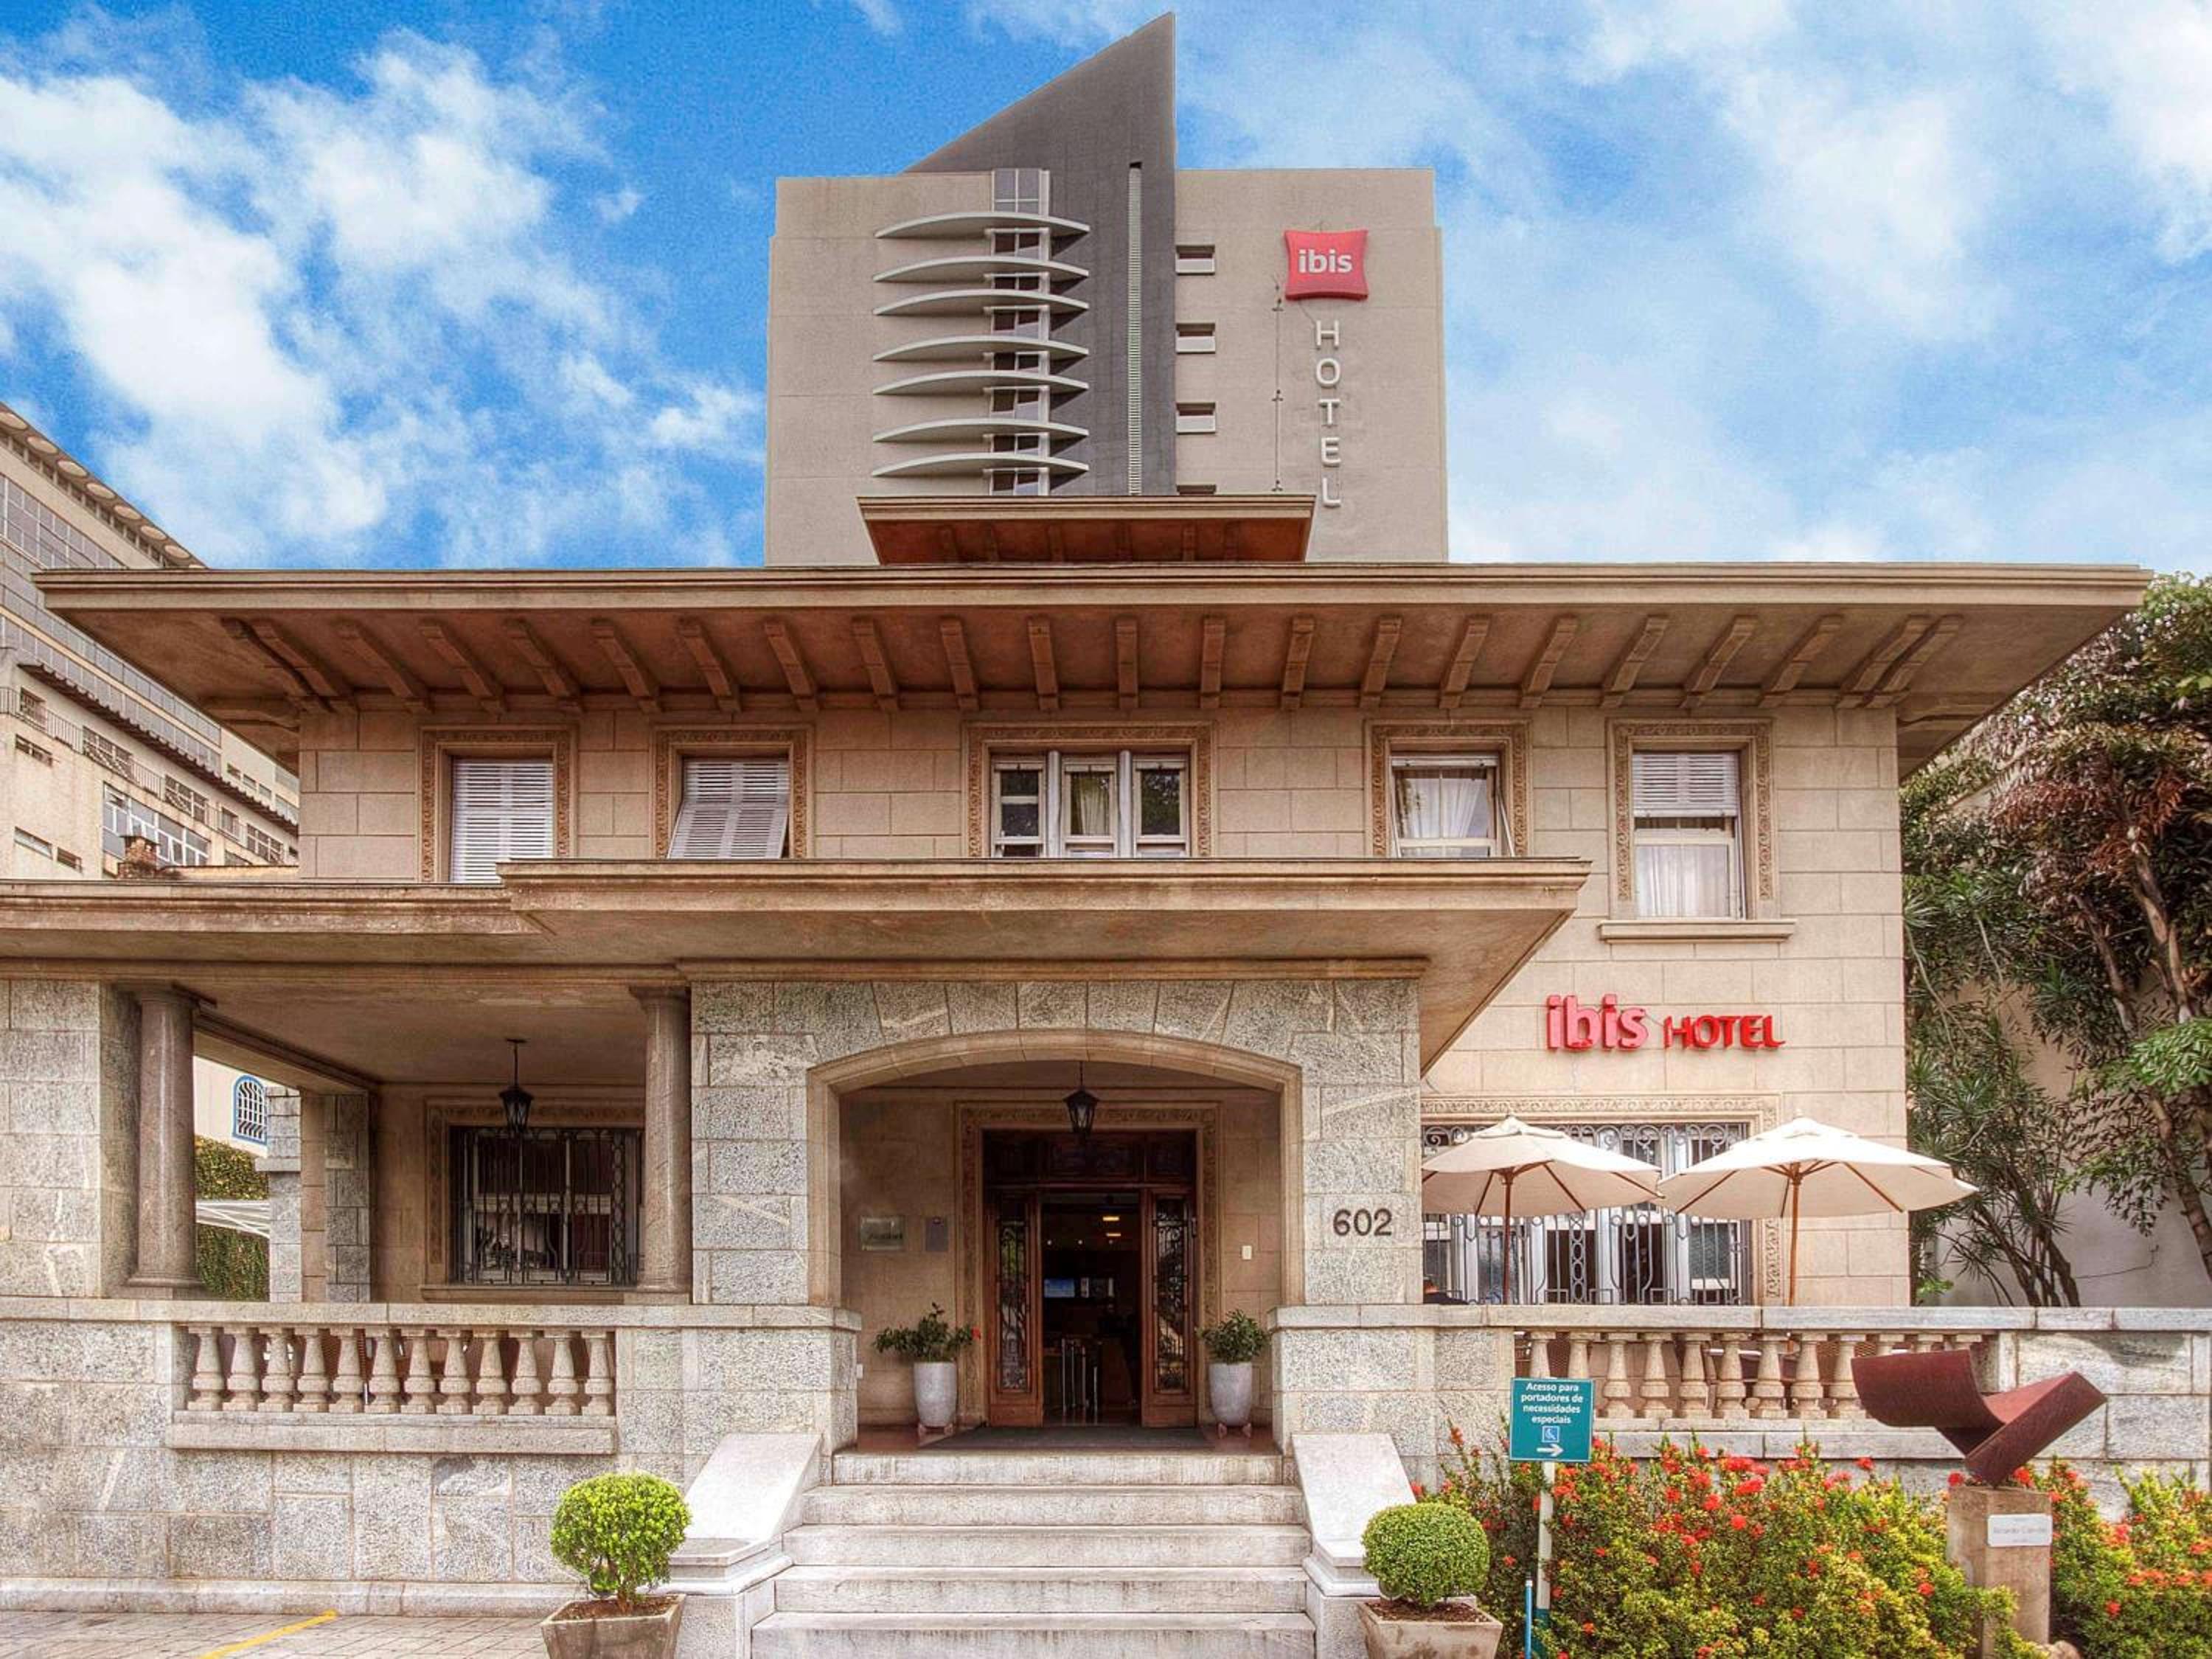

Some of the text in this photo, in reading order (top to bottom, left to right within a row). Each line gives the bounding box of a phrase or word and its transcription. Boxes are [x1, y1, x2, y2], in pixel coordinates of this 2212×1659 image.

[1298, 249, 1353, 274] ibis
[1315, 319, 1341, 507] HOTEL
[1546, 994, 1787, 1049] ibis HOTEL
[1332, 1208, 1393, 1237] 602
[1526, 1382, 1579, 1393] Acesso para
[1520, 1393, 1584, 1403] portadores de
[1523, 1403, 1581, 1413] necessidades
[1531, 1415, 1571, 1425] especiais
